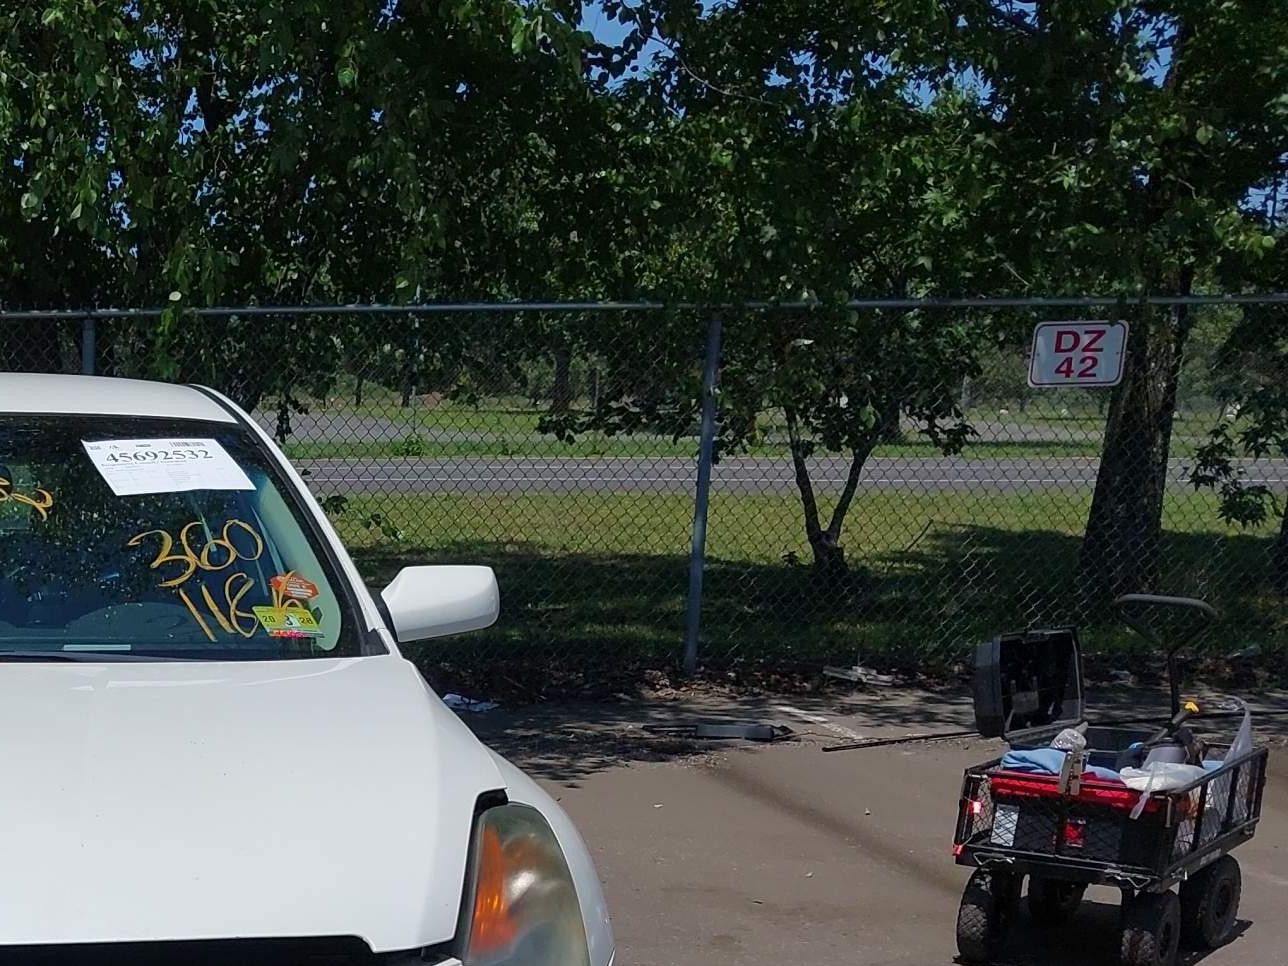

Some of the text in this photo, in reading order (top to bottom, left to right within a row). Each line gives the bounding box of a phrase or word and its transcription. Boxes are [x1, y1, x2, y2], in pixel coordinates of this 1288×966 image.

[1054, 330, 1106, 353] DZ
[1054, 356, 1098, 378] 42
[106, 450, 214, 463] 45692532
[127, 519, 263, 587] 360
